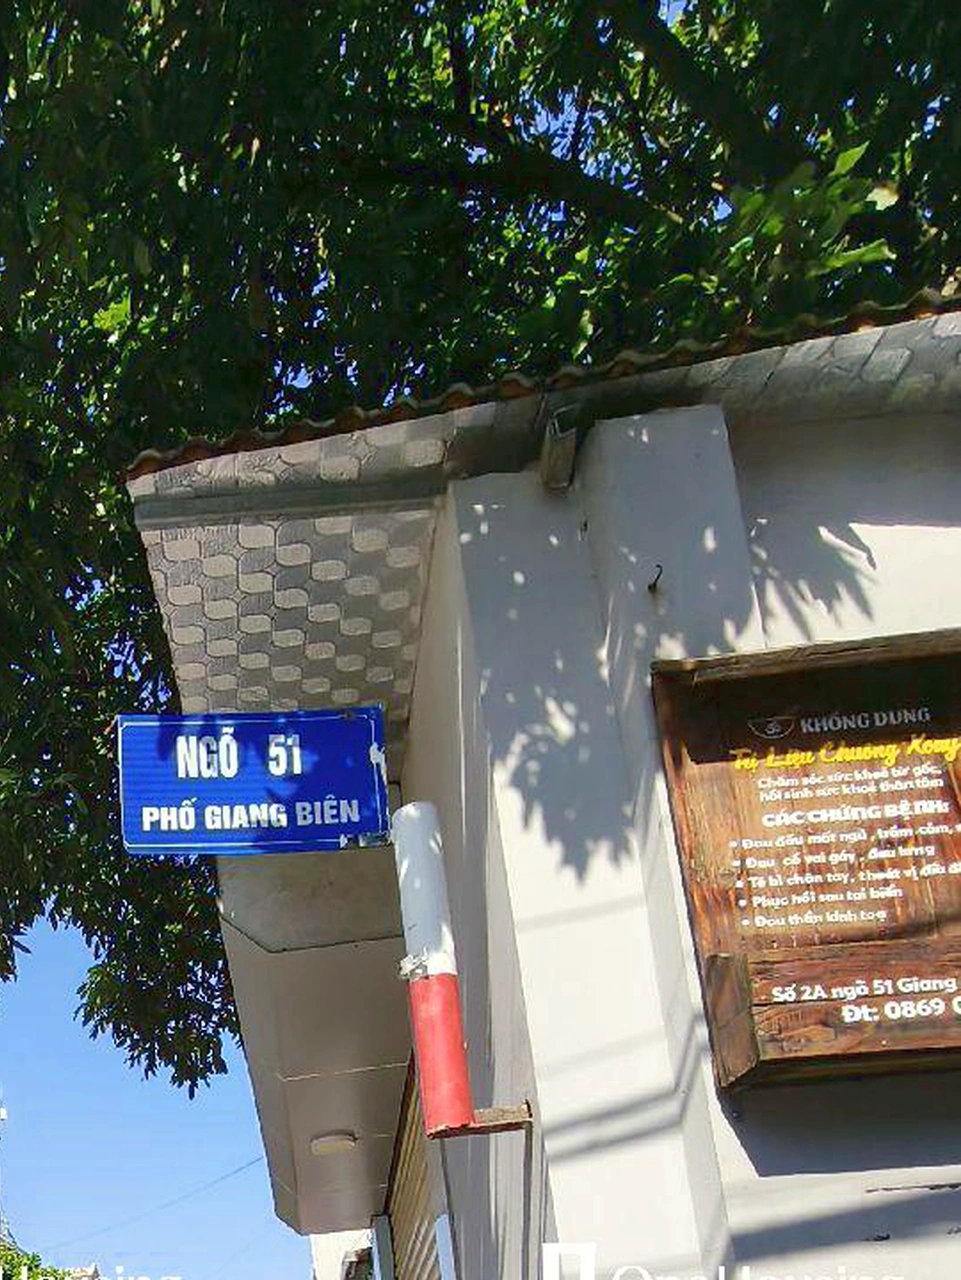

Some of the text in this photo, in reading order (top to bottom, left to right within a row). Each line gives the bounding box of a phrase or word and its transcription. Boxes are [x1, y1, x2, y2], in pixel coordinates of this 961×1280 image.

[176, 727, 303, 778] NGÕ 51
[142, 795, 360, 831] PHỐ GIANG BIÊN
[761, 810, 805, 827] CÁC
[772, 976, 957, 1002] Số 2A ngõ 51 Giang
[884, 997, 946, 1019] 0869
